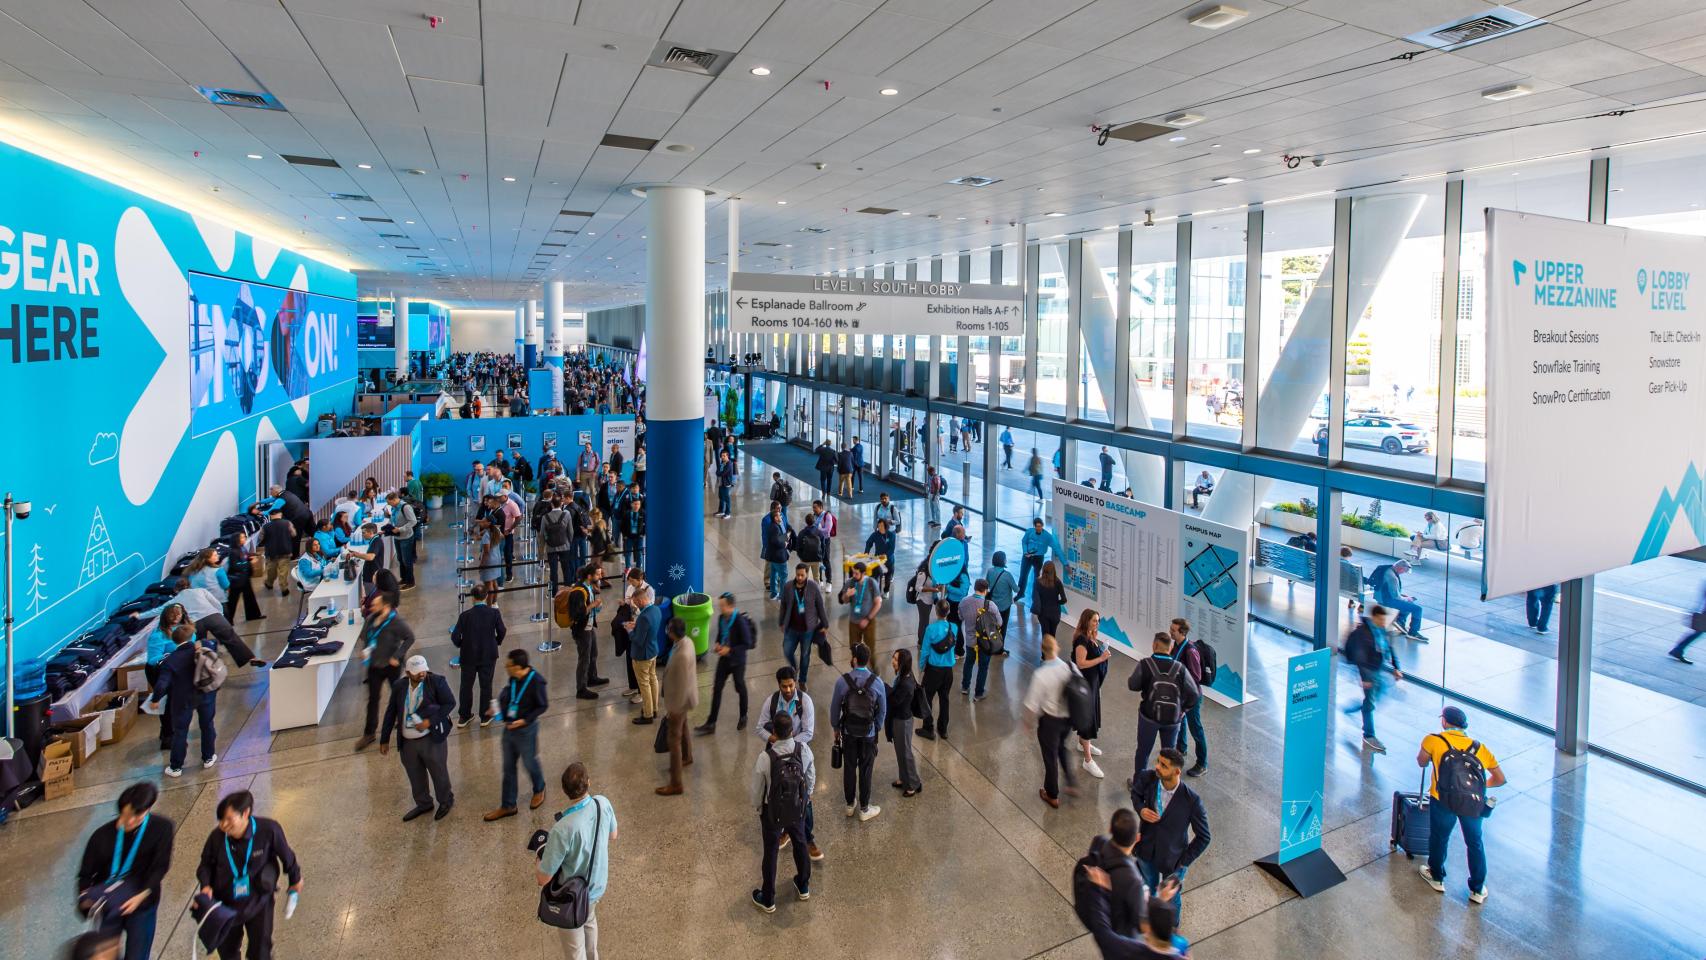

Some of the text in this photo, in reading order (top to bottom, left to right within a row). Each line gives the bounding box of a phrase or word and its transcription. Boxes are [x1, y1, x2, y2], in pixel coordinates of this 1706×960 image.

[0, 225, 101, 297] GEAR
[1534, 260, 1584, 284] UPPER
[1652, 270, 1690, 290] LOBBY
[813, 279, 963, 297] LEVEL 1 SOUTH LOBBY
[1534, 284, 1617, 309] MEZZANINE
[1651, 292, 1686, 310] LEVEL
[751, 298, 854, 314] Esplanade Ballroom
[927, 304, 1009, 316] Exhibition Halls A-F
[751, 316, 832, 329] Rooms 104-160
[956, 321, 1009, 332] Rooms 1-105
[0, 303, 100, 364] HERE
[1533, 329, 1599, 344] Breakout Sessions
[1650, 331, 1701, 343] The Lift: Check-In
[304, 310, 338, 378] ON!
[1533, 359, 1601, 375] Snowflake Training
[1649, 356, 1681, 369] Snowstore
[1648, 381, 1687, 395] Gear Pick-Up
[1533, 388, 1610, 405] SnowPro Certification
[1055, 486, 1072, 499] YOUR
[1073, 491, 1094, 504] GUIDE
[1094, 496, 1105, 507] TO
[1105, 500, 1147, 519] BASECAMP
[1185, 524, 1222, 539] CAMPUS MAP
